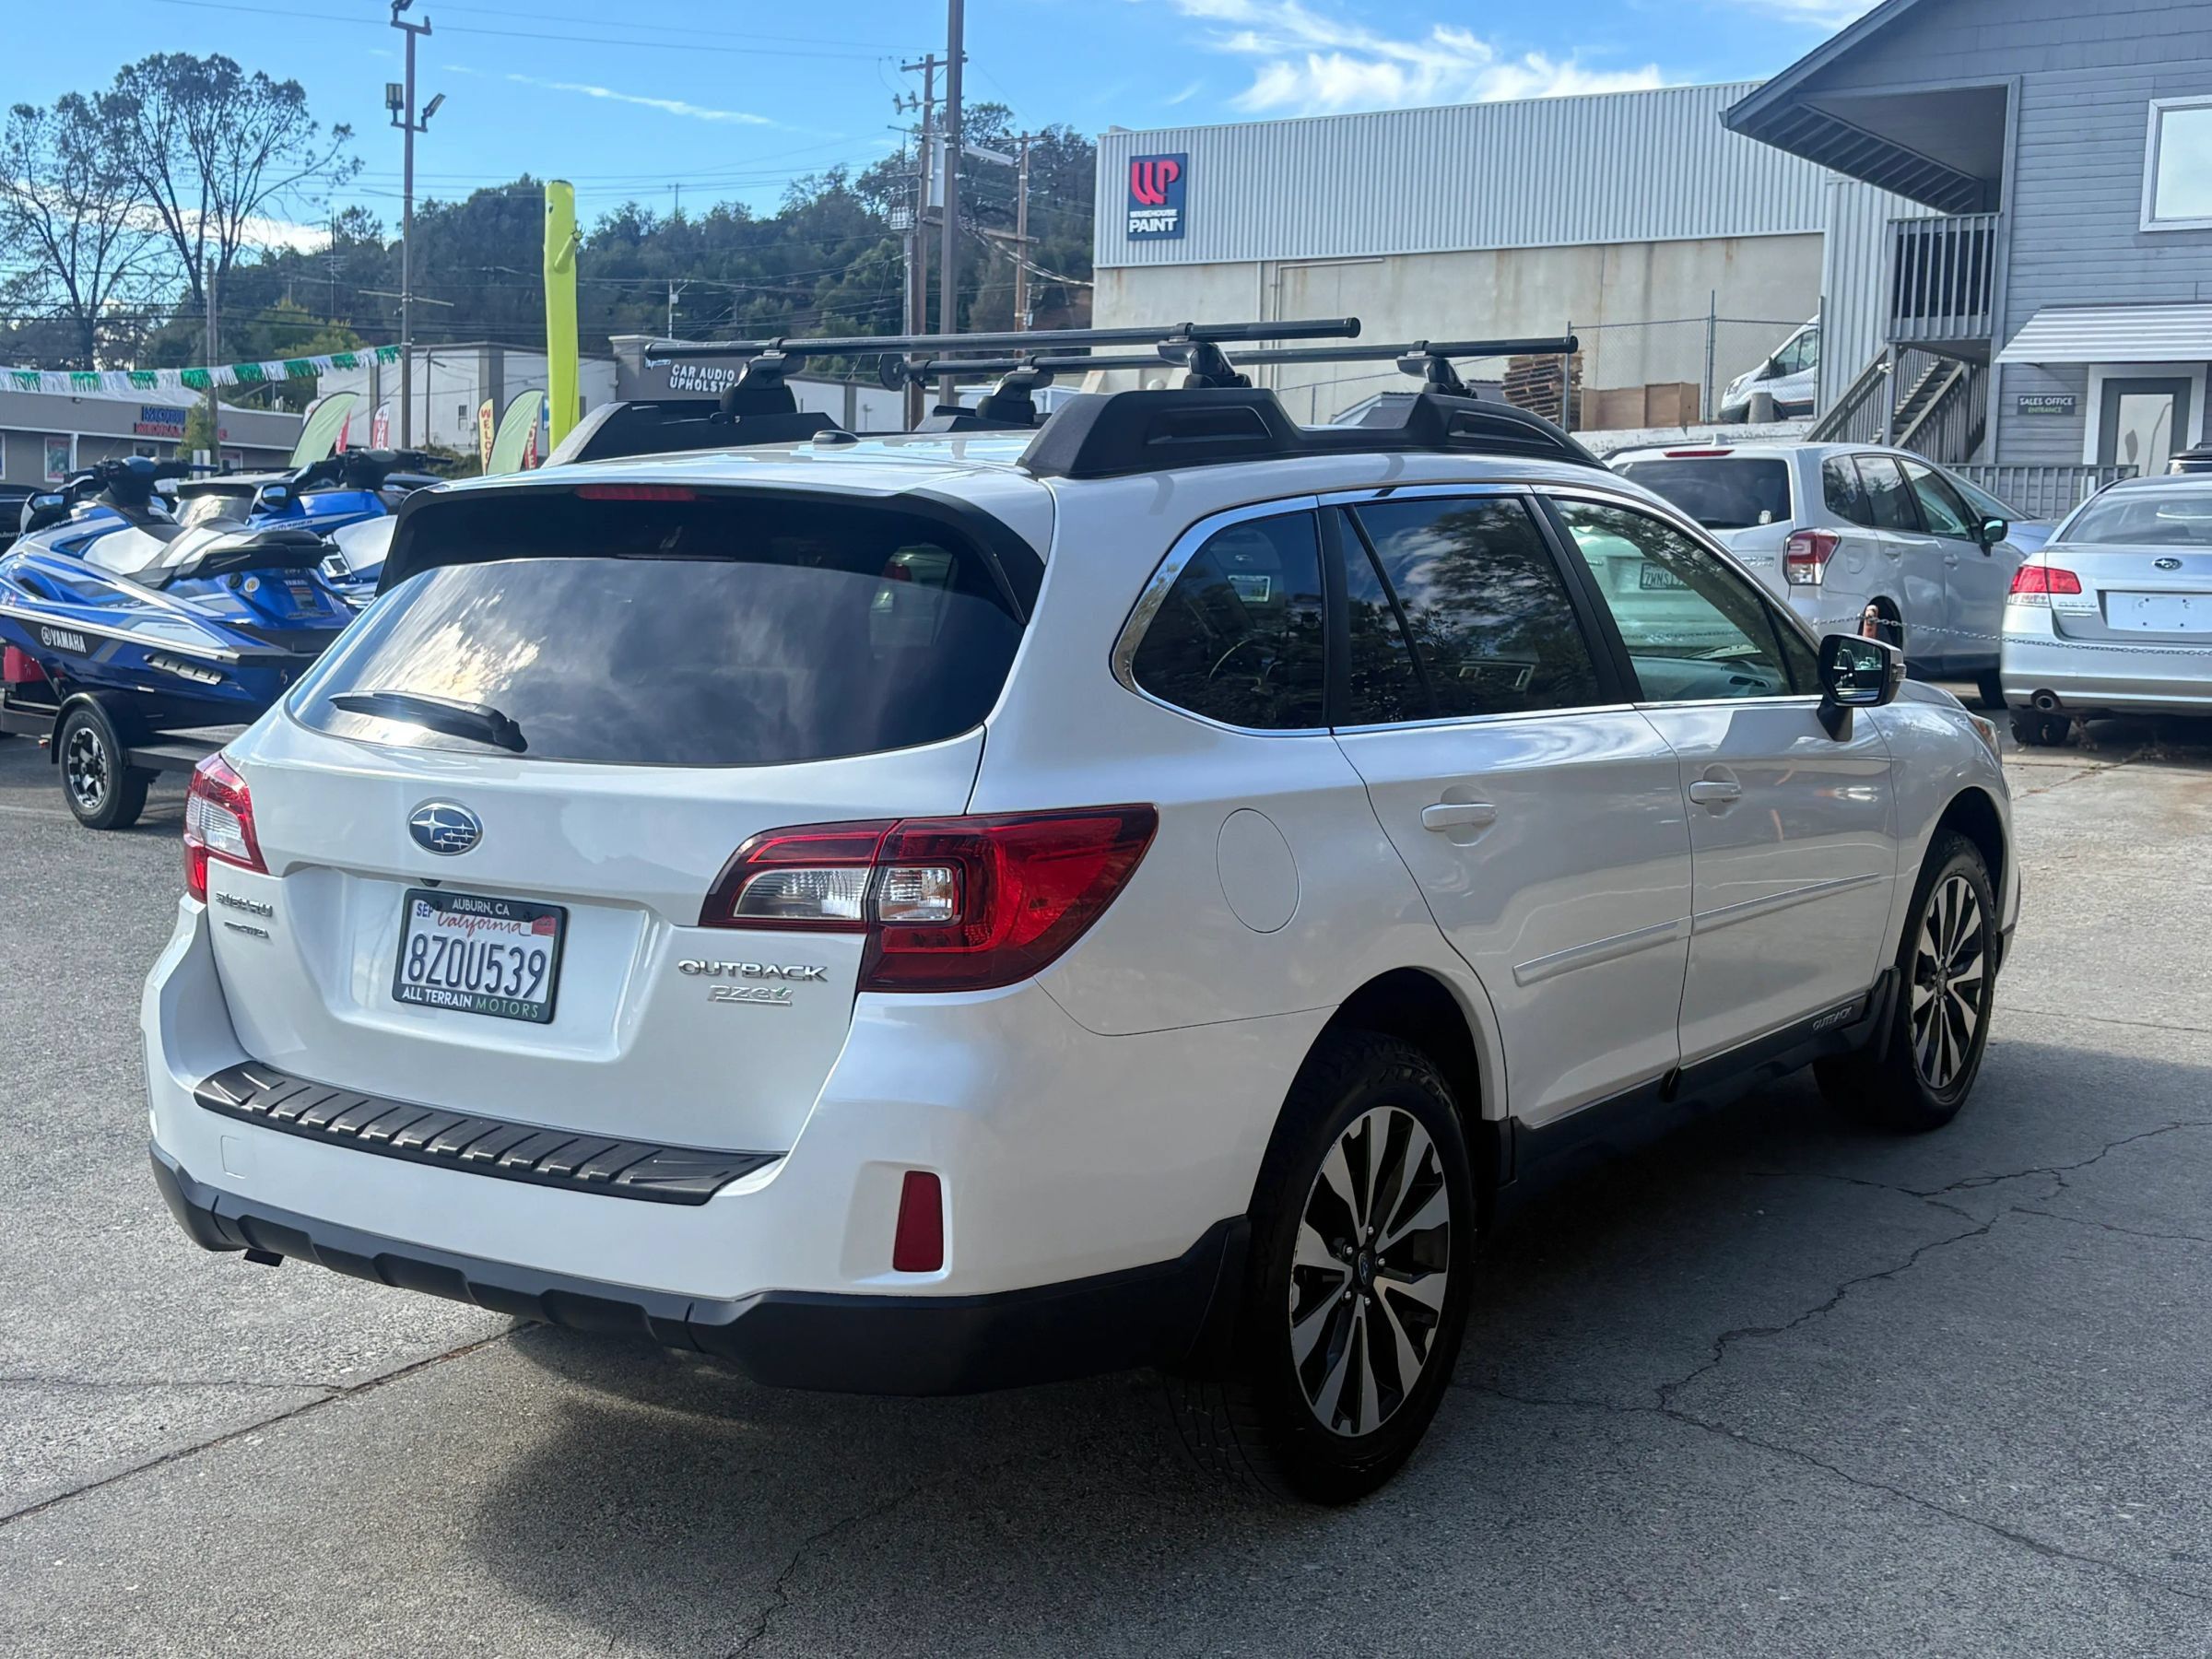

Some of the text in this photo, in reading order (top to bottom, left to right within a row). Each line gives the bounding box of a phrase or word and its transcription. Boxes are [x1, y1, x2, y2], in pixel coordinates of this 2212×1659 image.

[1128, 218, 1179, 233] PAINT
[672, 363, 695, 378] CAR
[700, 366, 735, 382] AUDIO
[669, 376, 735, 394] UPHOLST
[2019, 397, 2073, 406] SALES OFFICE
[51, 628, 87, 653] YAMAHA
[452, 898, 510, 916] AUBURN, CA
[437, 911, 531, 938] California
[678, 959, 829, 982] OUTBACK
[402, 986, 539, 1019] ALL TERRAIN MOTORS
